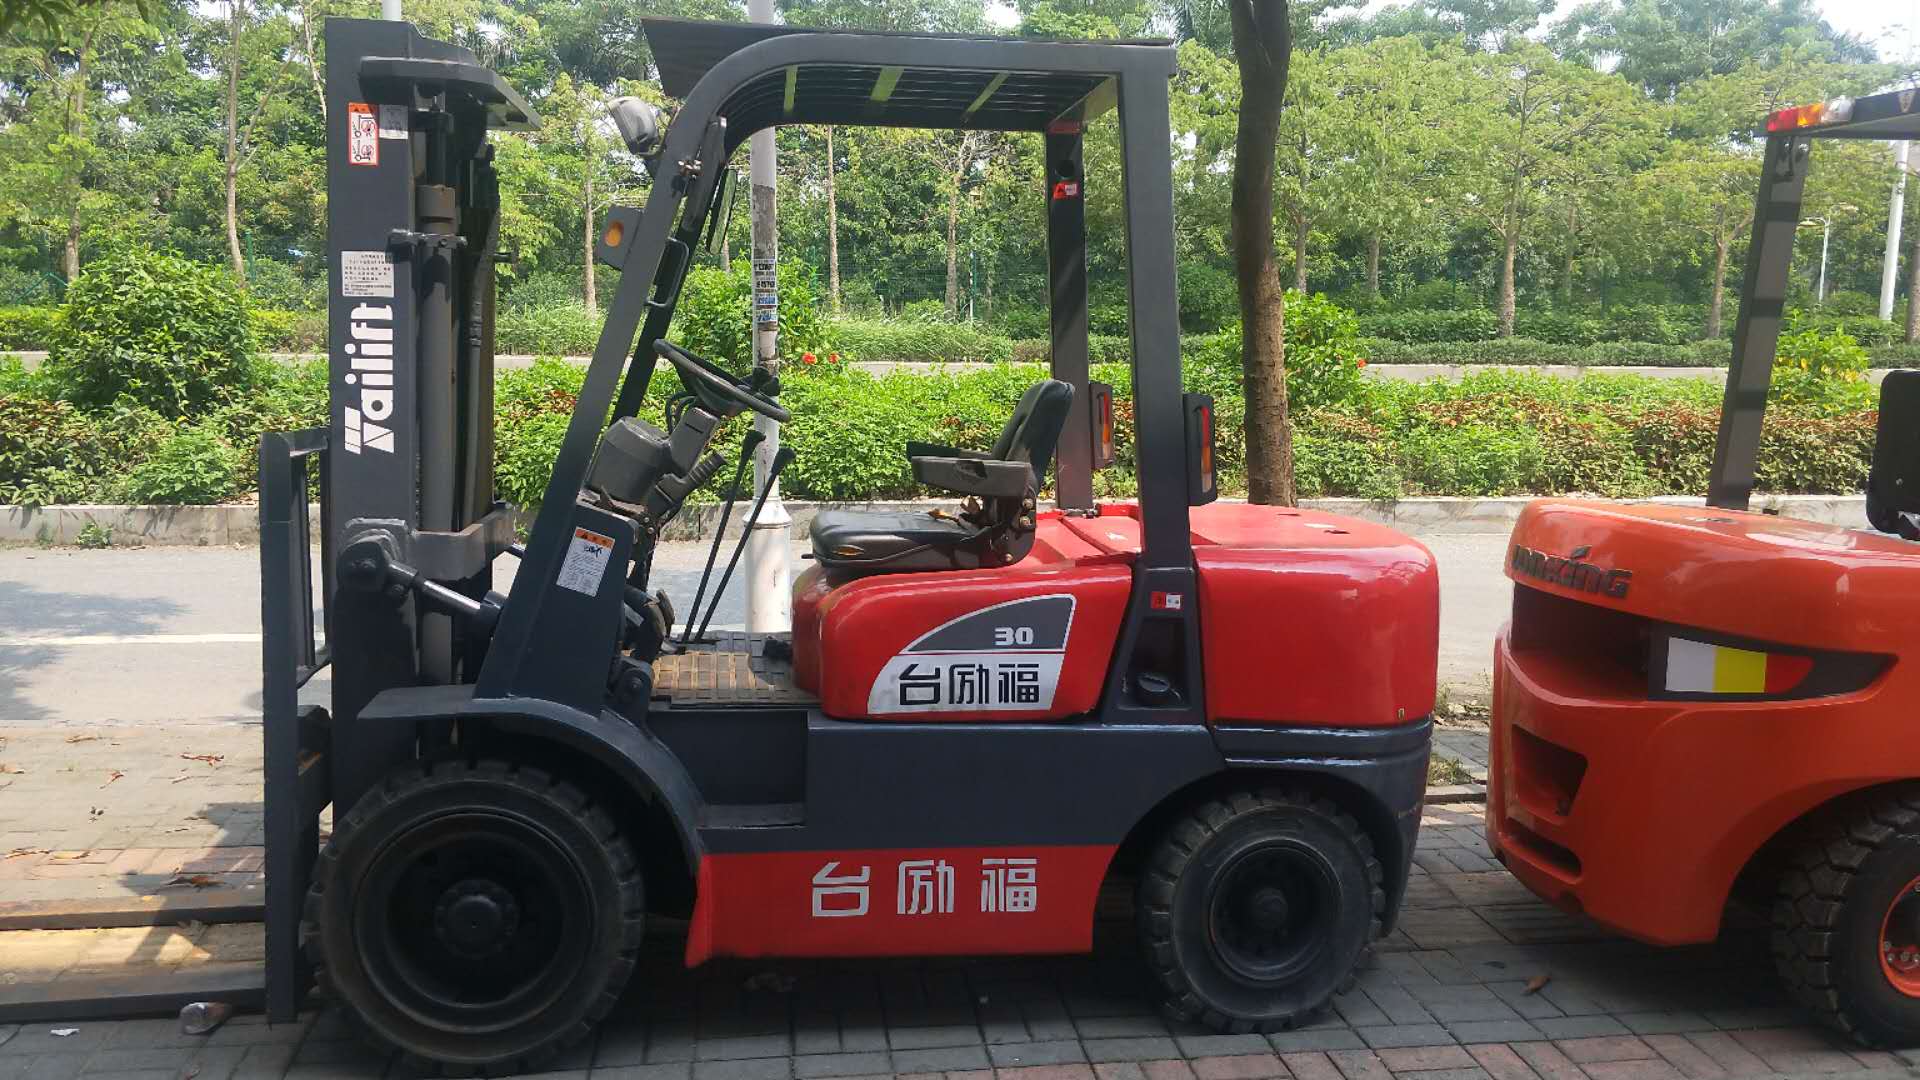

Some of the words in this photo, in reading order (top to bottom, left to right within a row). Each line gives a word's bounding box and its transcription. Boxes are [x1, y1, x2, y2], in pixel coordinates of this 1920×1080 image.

[994, 626, 1035, 646] 30
[898, 663, 1040, 705] 台励福
[812, 858, 1038, 917] 台励福
